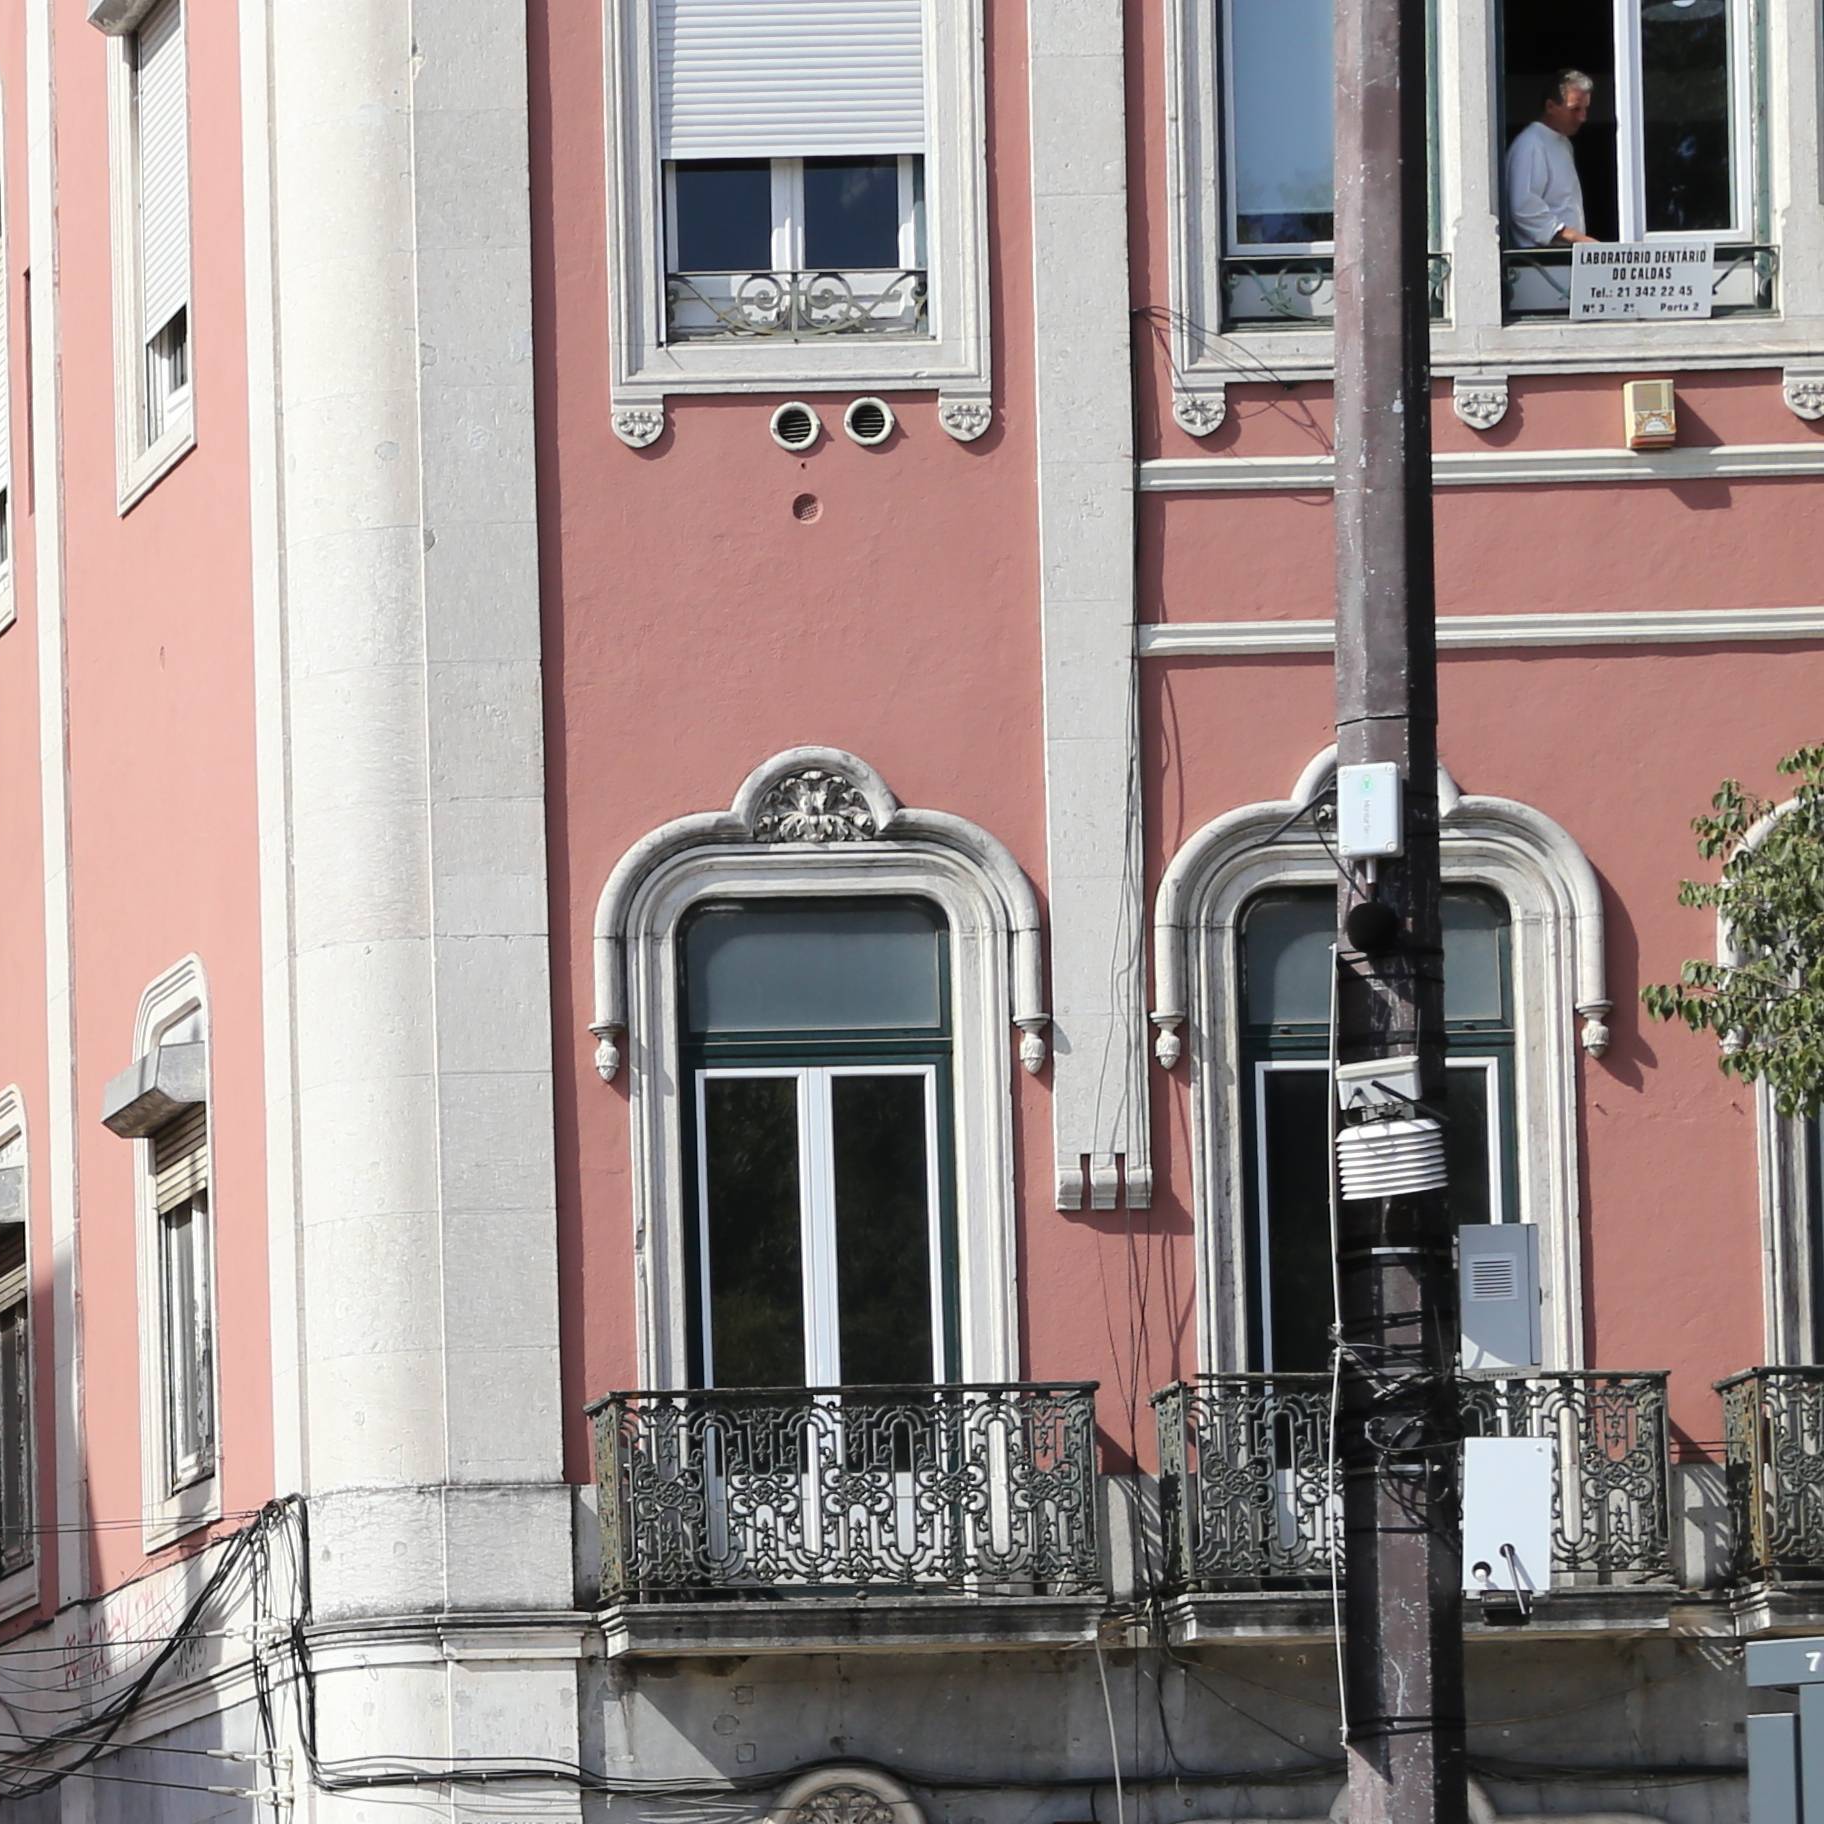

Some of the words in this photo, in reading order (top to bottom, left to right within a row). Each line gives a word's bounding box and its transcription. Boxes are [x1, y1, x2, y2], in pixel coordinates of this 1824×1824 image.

[1580, 249, 1651, 265] LABORATÓRIO
[1654, 247, 1706, 264] DENTÁRIO
[1612, 267, 1627, 280] DO
[1630, 266, 1672, 280] CALDAS
[1591, 287, 1613, 298] Tel.:
[1617, 287, 1631, 298] 21
[1634, 286, 1656, 297] 342
[1660, 286, 1675, 297] 22
[1678, 285, 1693, 296] 45
[1660, 302, 1689, 312] Porta
[1693, 302, 1700, 311] 2
